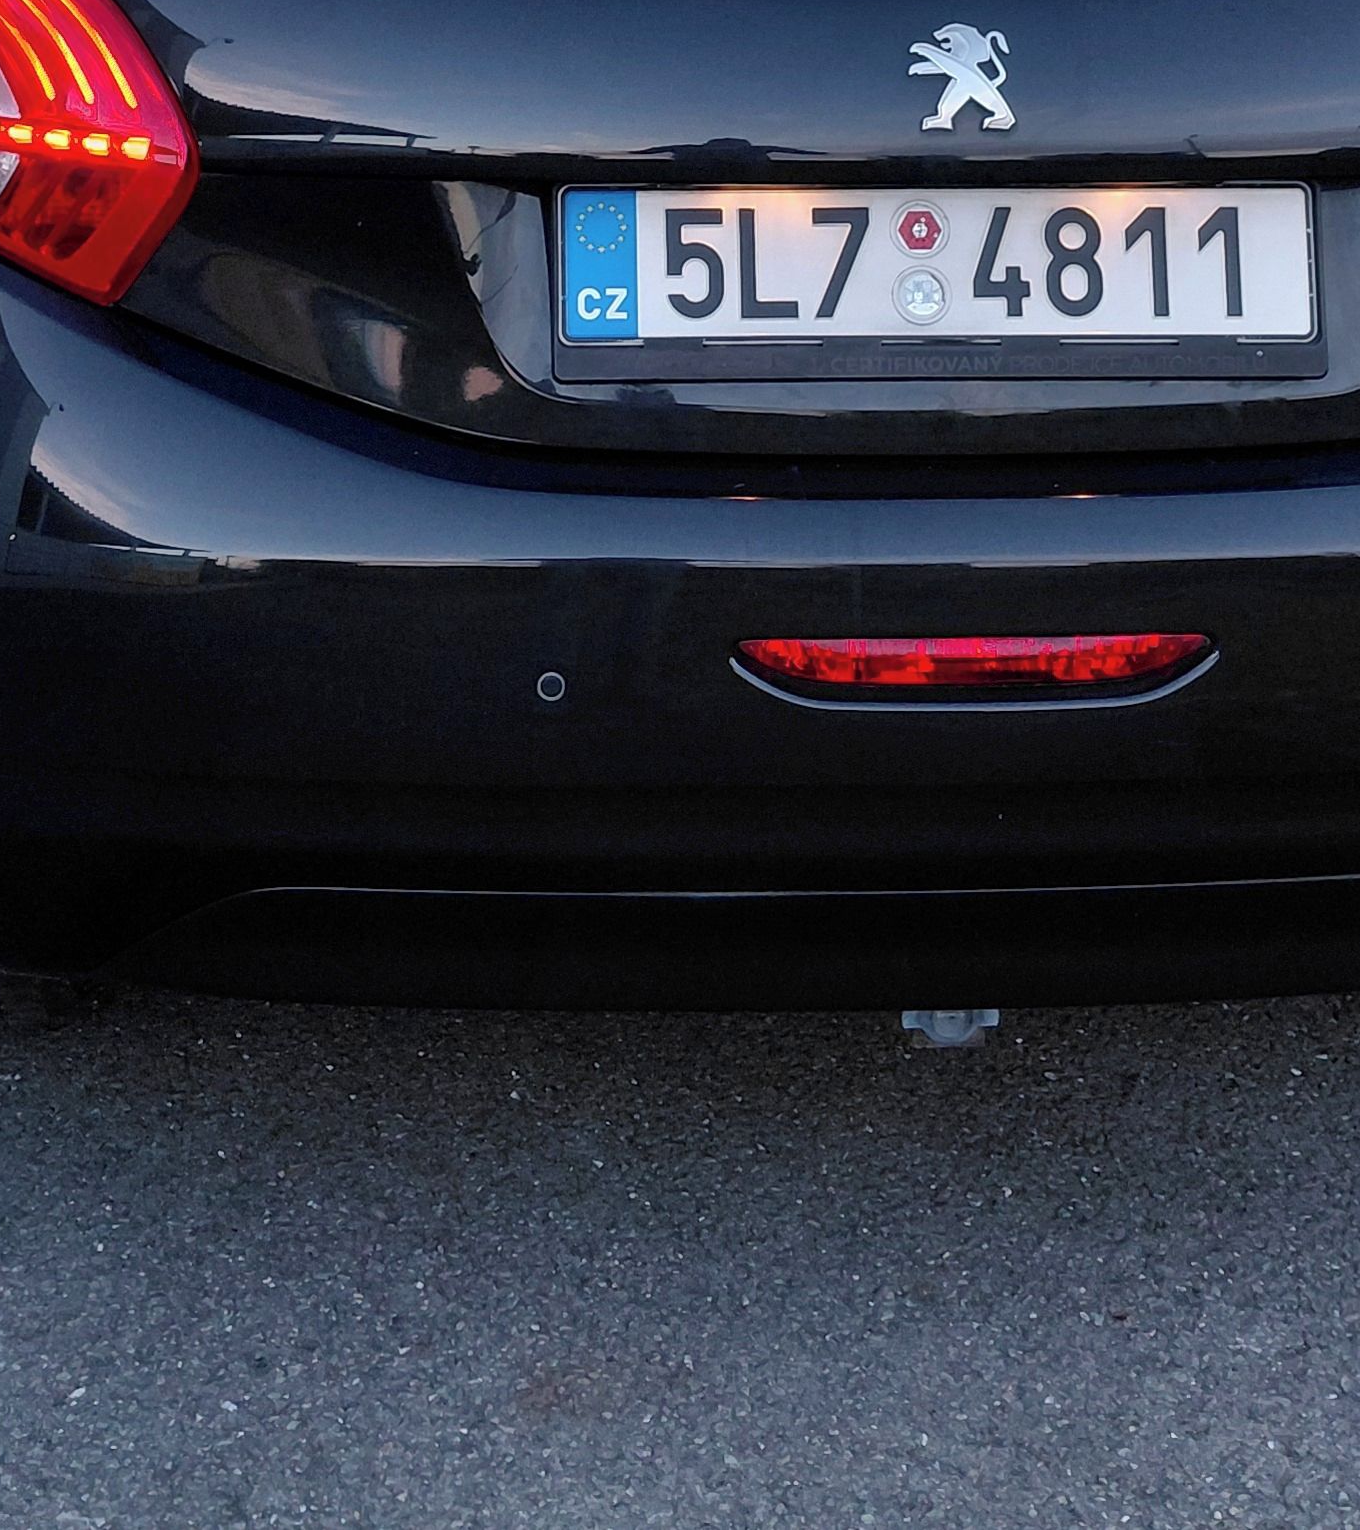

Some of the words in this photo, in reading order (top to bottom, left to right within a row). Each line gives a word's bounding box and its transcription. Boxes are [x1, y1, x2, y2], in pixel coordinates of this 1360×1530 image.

[665, 207, 870, 319] 5L7
[972, 206, 1244, 318] 4811
[577, 287, 628, 321] CZ
